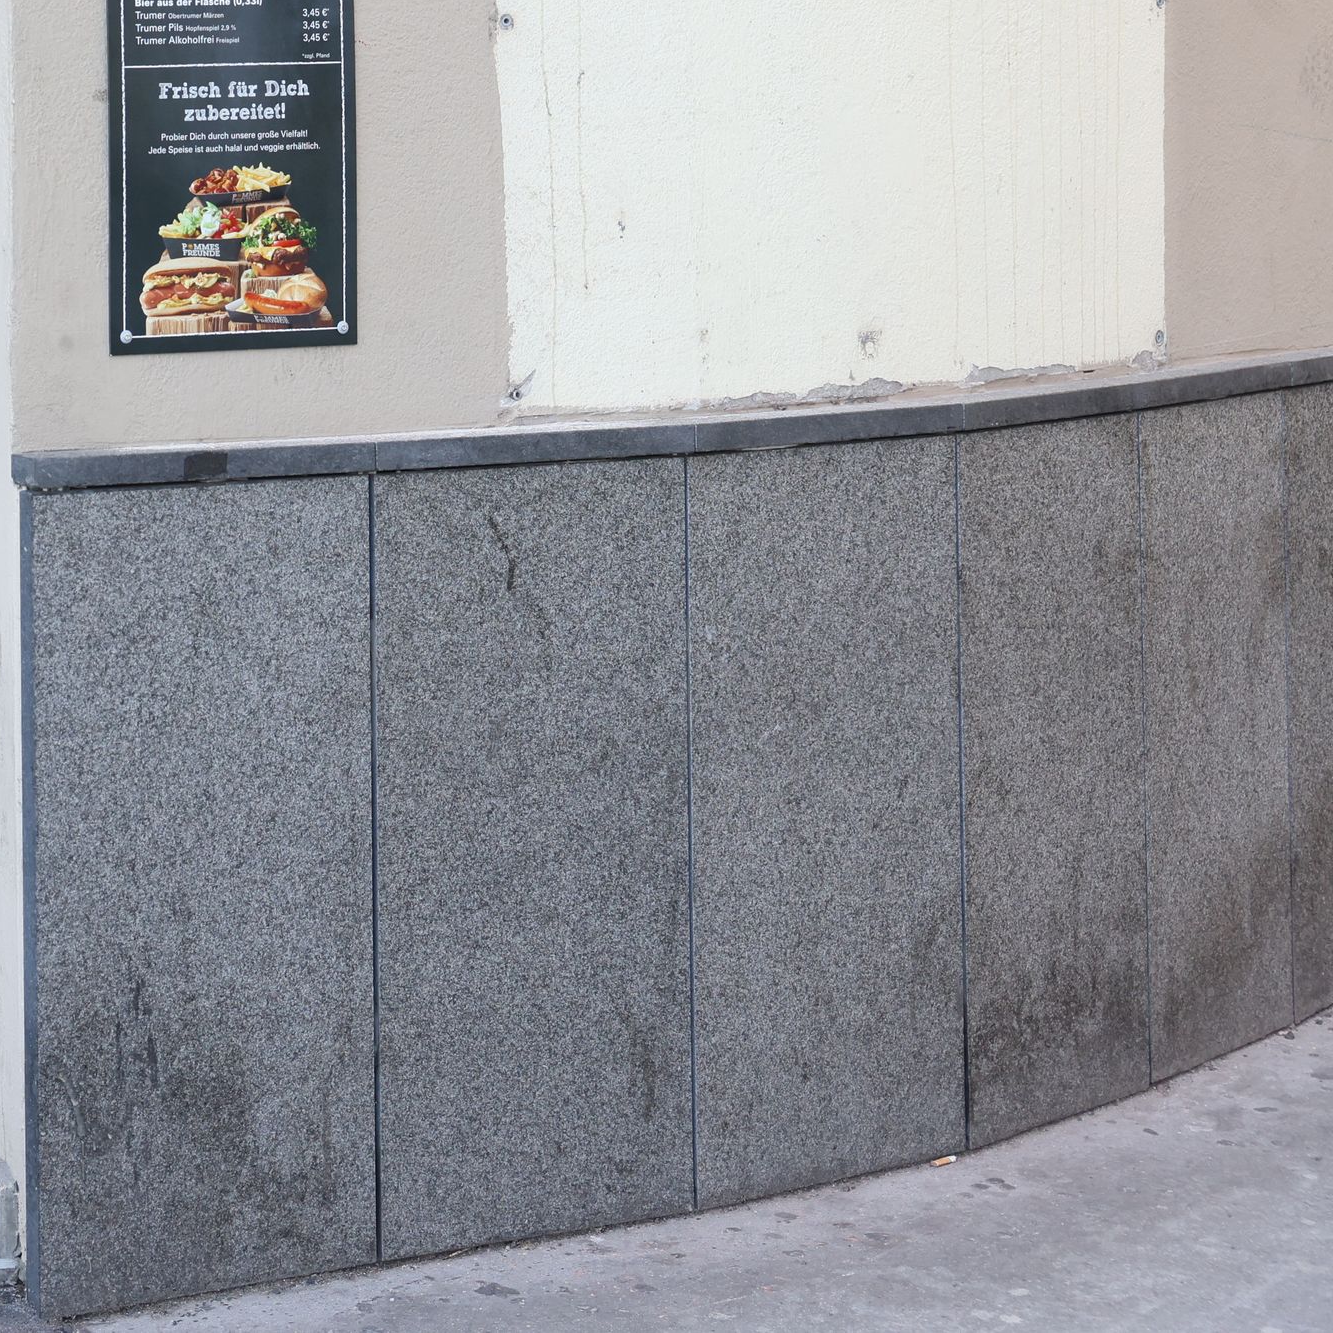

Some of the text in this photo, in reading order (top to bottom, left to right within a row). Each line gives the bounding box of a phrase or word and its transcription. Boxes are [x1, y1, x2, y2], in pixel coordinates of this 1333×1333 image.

[156, 0, 174, 7] aus
[158, 79, 310, 100] Frisch für Dich
[184, 102, 286, 122] zubereitet!
[160, 129, 308, 141] Probier Dich durch unsere große Vielfalt!
